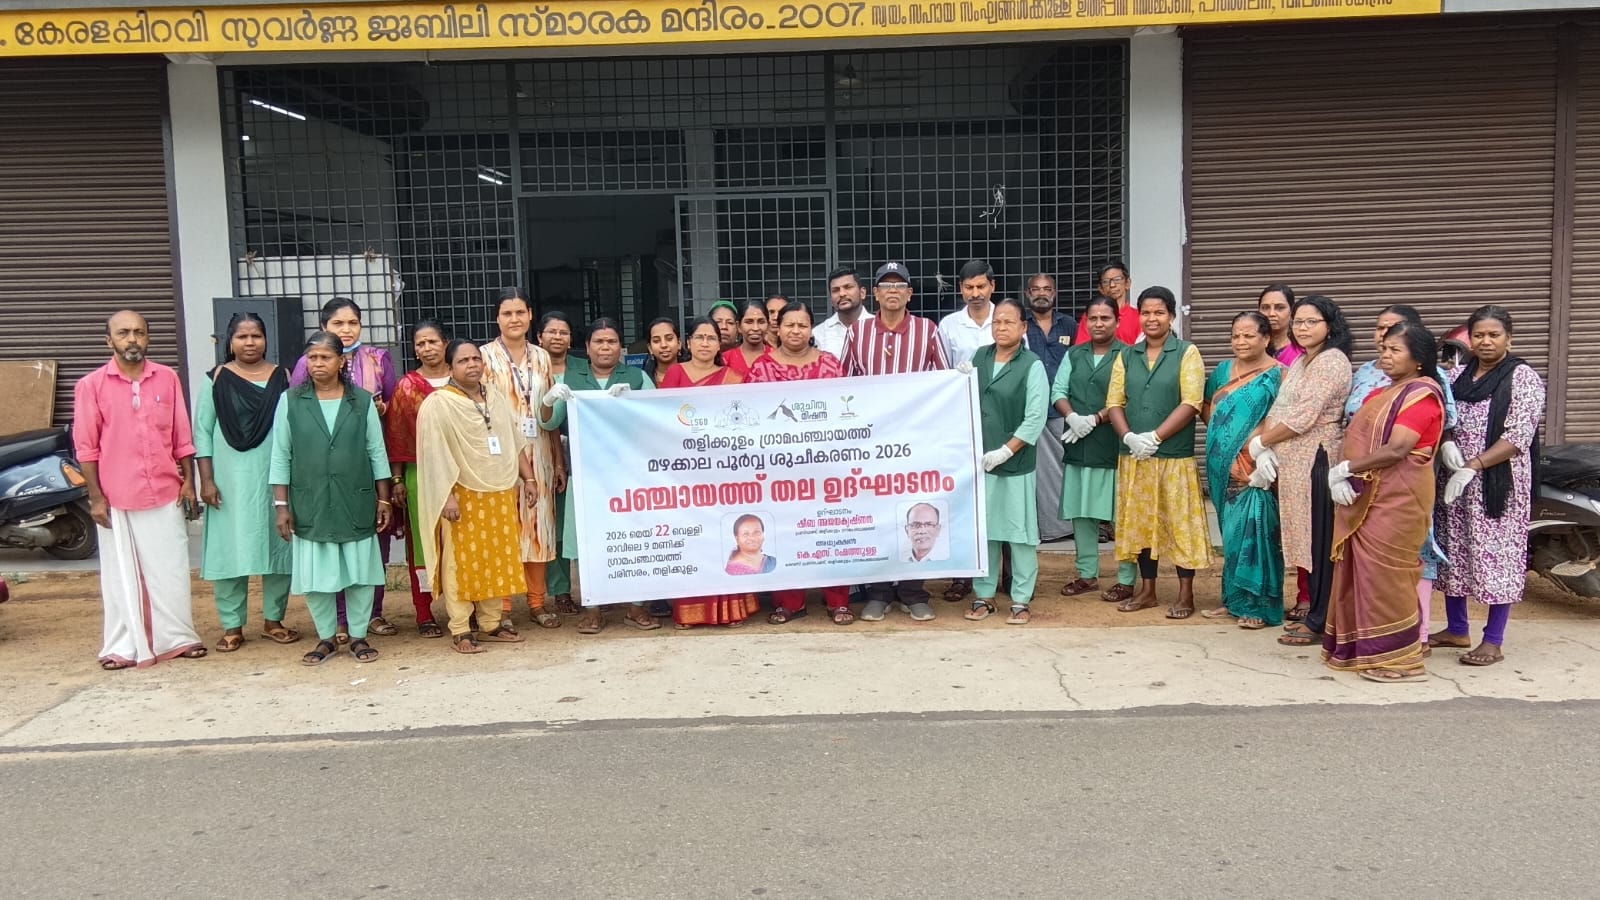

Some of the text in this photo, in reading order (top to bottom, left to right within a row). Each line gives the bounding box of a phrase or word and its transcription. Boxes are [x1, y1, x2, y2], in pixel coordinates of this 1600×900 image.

[15, 10, 208, 46] കേരളപ്പിറവി
[221, 9, 358, 48] സുവർണ്ണ
[368, 3, 490, 41] ജൂബിലി
[499, 5, 651, 37] സ്മാരക
[682, 424, 872, 452] തളിക്കുളം ഗ്രാമപഞ്ചായത്ത്
[648, 443, 912, 472] മഴക്കാല പൂർവ്വ ശുചീകരണം 2026
[609, 468, 955, 512] പഞ്ചായത്ത് തല ഉദ്ഘാടനം
[606, 531, 627, 541] 2026
[655, 524, 670, 537] 22
[672, 524, 703, 537] വെള്ളി
[607, 543, 642, 553] രാവിലെ
[644, 542, 650, 551] 9
[607, 552, 683, 568] ഗ്രാമപഞ്ചായത്ത്
[652, 565, 698, 577] തളിക്കുളം
